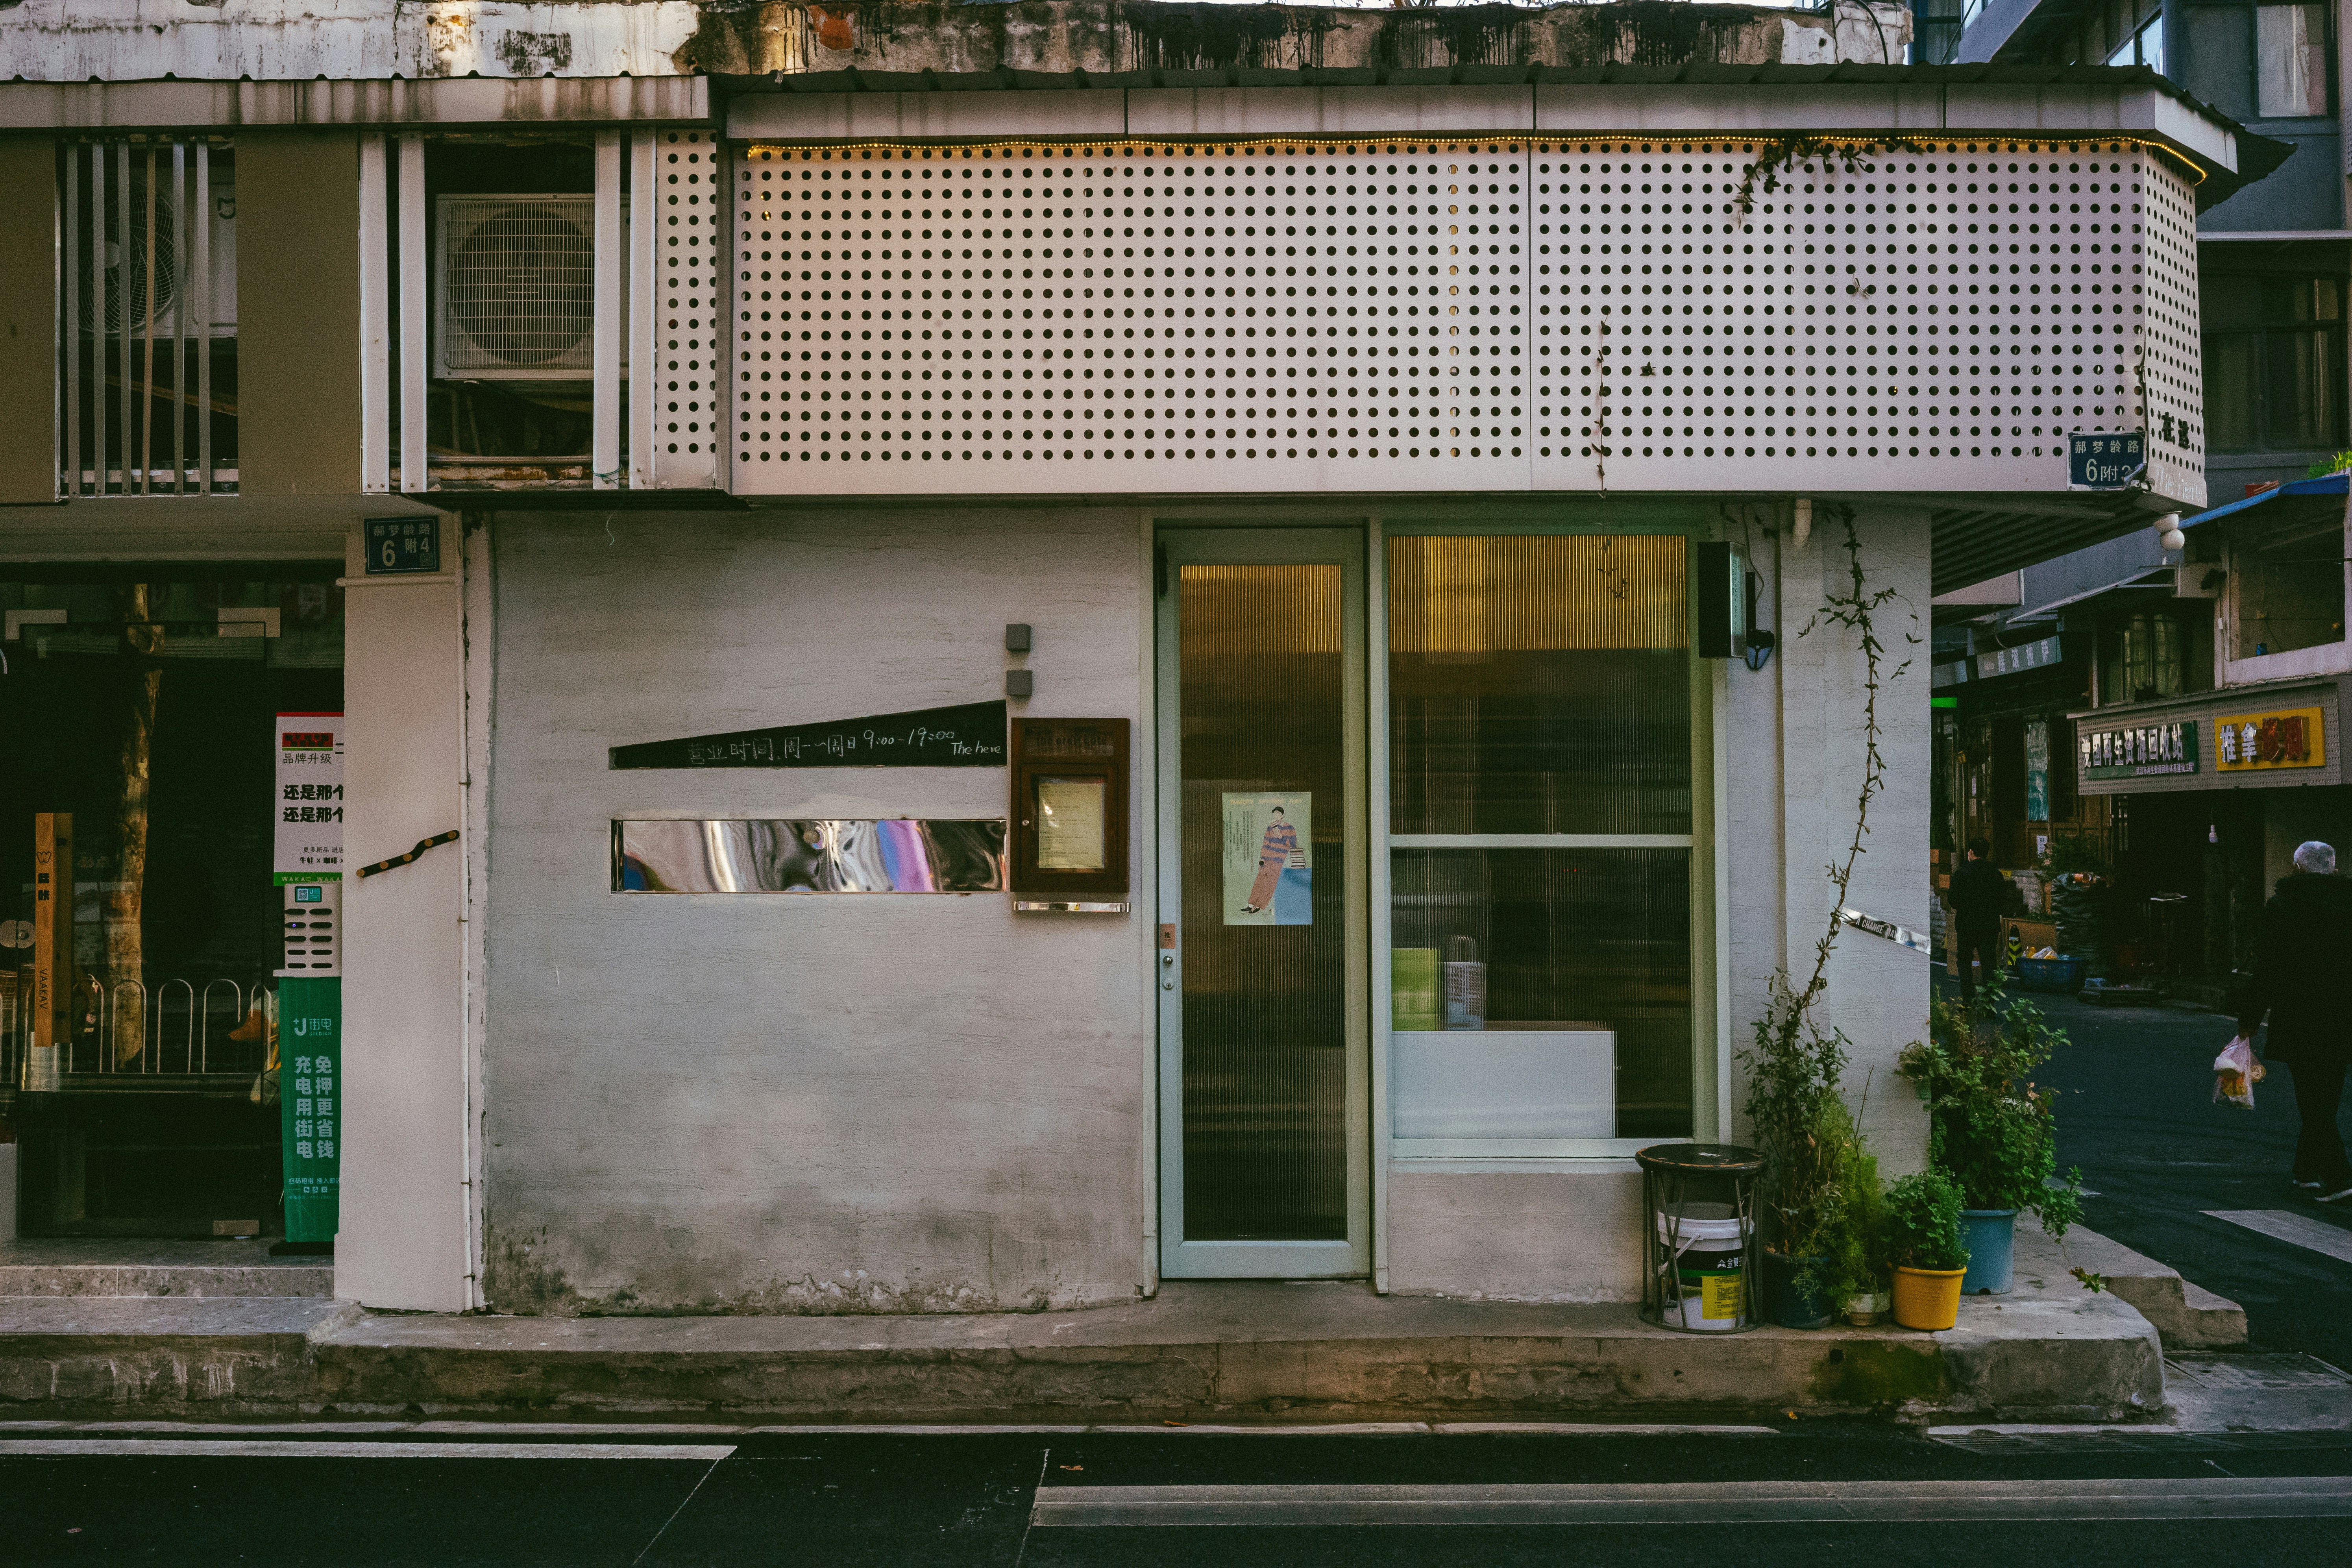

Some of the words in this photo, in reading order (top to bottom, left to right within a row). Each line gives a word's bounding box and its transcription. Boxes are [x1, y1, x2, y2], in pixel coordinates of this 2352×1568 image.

[2075, 440, 2139, 453] 郝梦龄路
[374, 523, 430, 536] 郝梦龄路
[951, 740, 972, 755] The
[283, 753, 331, 764] 品牌升级
[283, 784, 343, 800] 还是那个
[283, 806, 343, 823] 还是那个
[309, 1018, 331, 1030] 街电
[294, 1056, 313, 1159] 充电用街电
[315, 1056, 334, 1159] 免押更省钱
